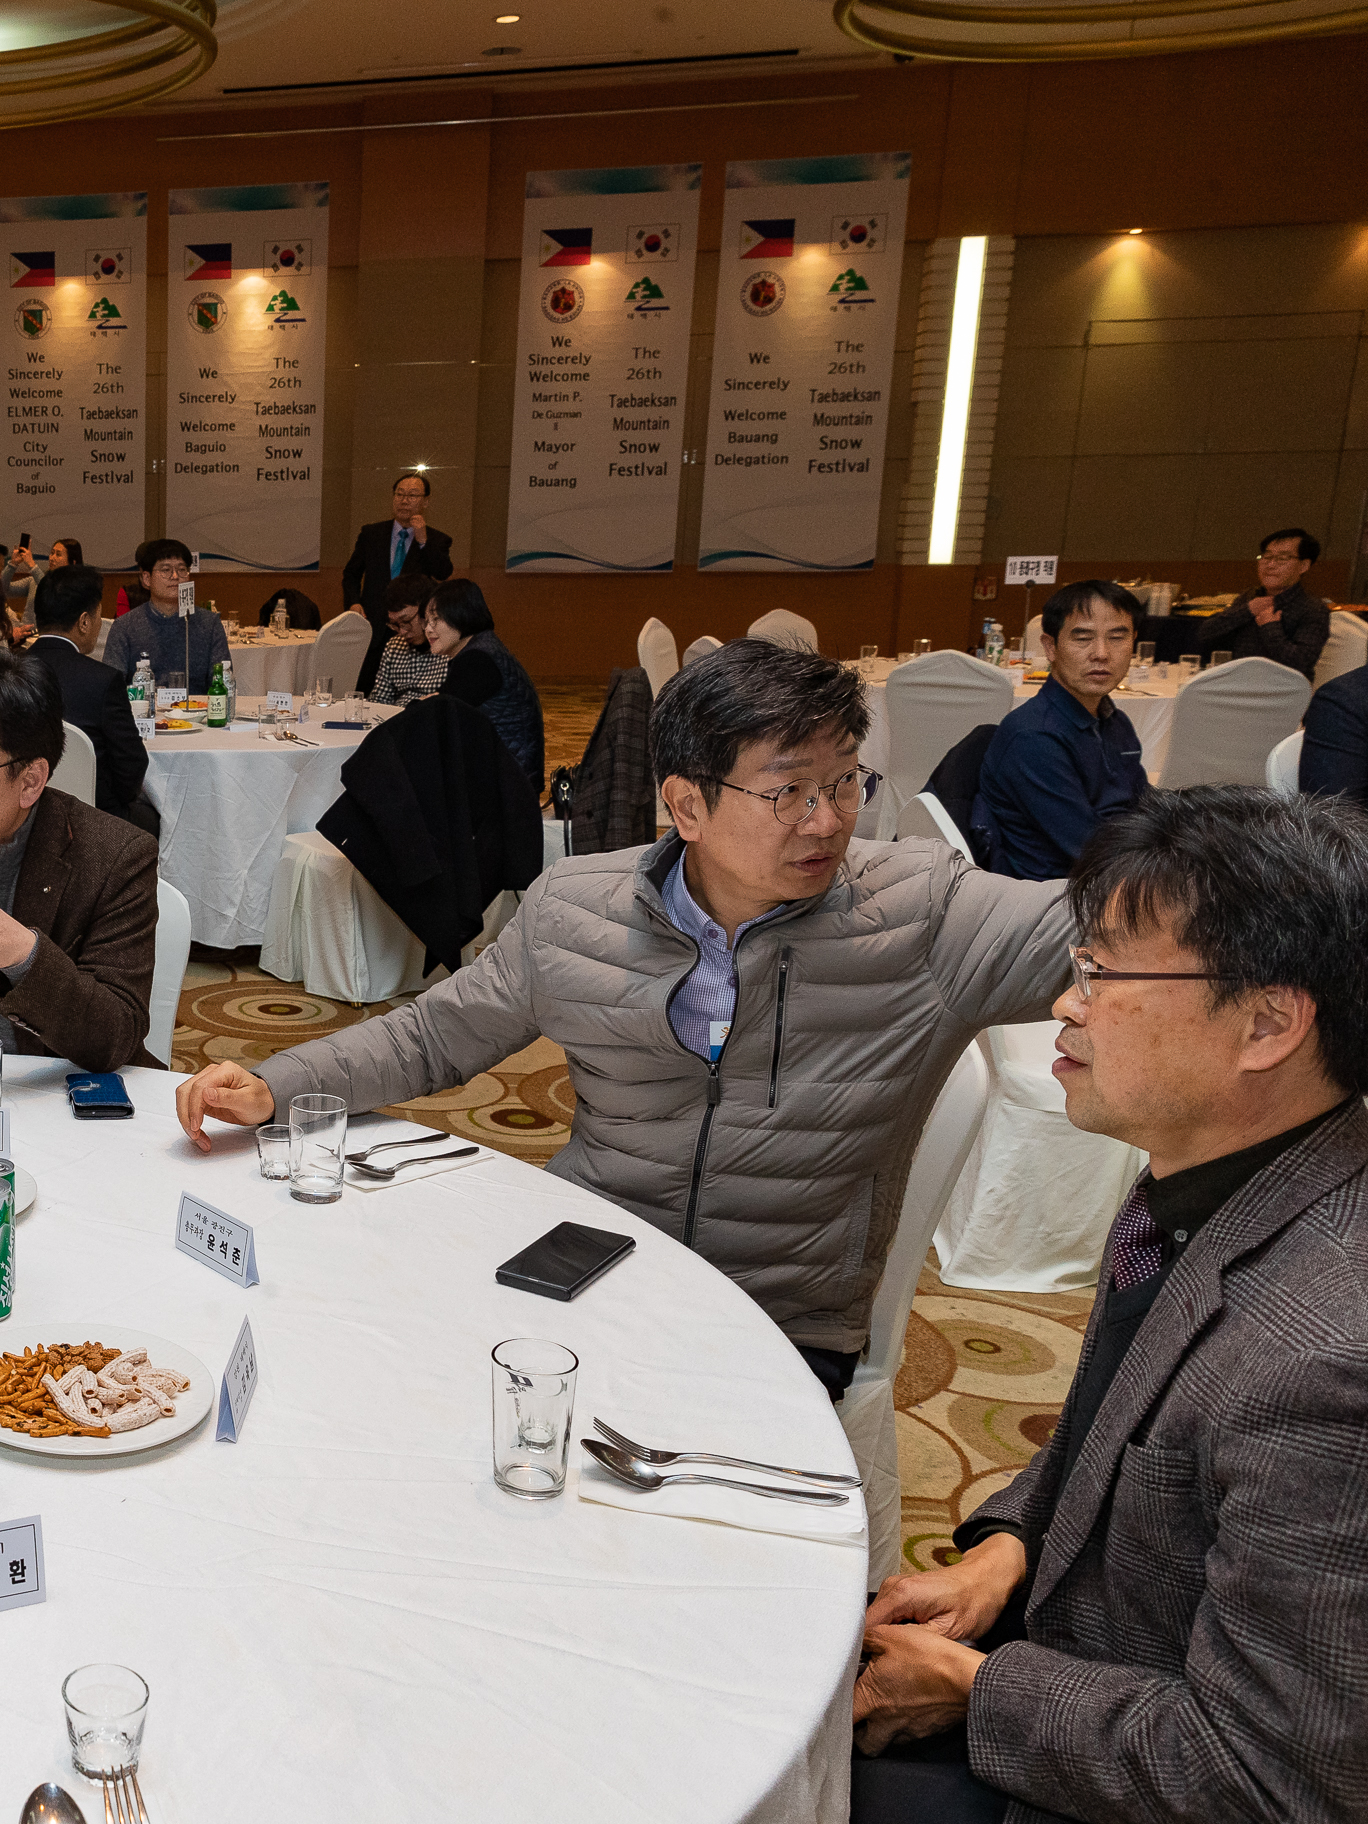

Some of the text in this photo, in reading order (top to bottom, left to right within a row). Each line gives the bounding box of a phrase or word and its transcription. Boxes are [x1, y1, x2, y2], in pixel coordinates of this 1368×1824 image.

[550, 336, 572, 348] We
[835, 340, 865, 353] The
[27, 352, 46, 364] We
[527, 352, 592, 367] Sincerely
[632, 346, 661, 360] The
[748, 352, 771, 365] We
[96, 362, 122, 375] The
[273, 357, 299, 369] The
[827, 361, 866, 375] 26th
[8, 367, 63, 381] Sincerely
[198, 368, 218, 379] We
[528, 370, 591, 383] Welcome
[626, 367, 662, 381] 26th
[92, 382, 124, 394] 26th
[268, 376, 302, 389] 26th
[724, 377, 790, 392] Sincerely
[9, 387, 64, 399] Welcome
[178, 391, 237, 405] Sincerely
[532, 391, 583, 403] Martin P.
[809, 387, 881, 404] Taebaeksan
[609, 393, 677, 409] Taebaeksan
[7, 405, 64, 417] ELMER O.
[79, 406, 138, 420] Taebaeksan
[254, 401, 317, 416] Taebaeksan
[532, 410, 582, 419] De Guzman
[723, 408, 787, 422] Welcome
[180, 420, 236, 433] Welcome
[612, 417, 670, 432] Mountain
[812, 412, 873, 427] Mountain
[12, 422, 59, 434] DATUIN
[83, 428, 133, 442] Mountain
[258, 423, 311, 438] Mountain
[727, 430, 779, 445] Bauang
[819, 435, 863, 451] Snow
[23, 441, 49, 453] City
[184, 441, 227, 455] Baguio
[264, 445, 303, 460] Snow
[533, 440, 576, 453] Mayor
[619, 439, 661, 454] Snow
[7, 455, 65, 467] Councilor
[90, 449, 126, 463] Snow
[714, 452, 789, 467] Delegation
[173, 461, 240, 475] Delegation
[547, 460, 558, 471] of
[31, 471, 40, 480] of
[528, 475, 577, 489] Bauang
[16, 482, 56, 496] Baguio
[194, 1212, 234, 1238] 서울 광진구
